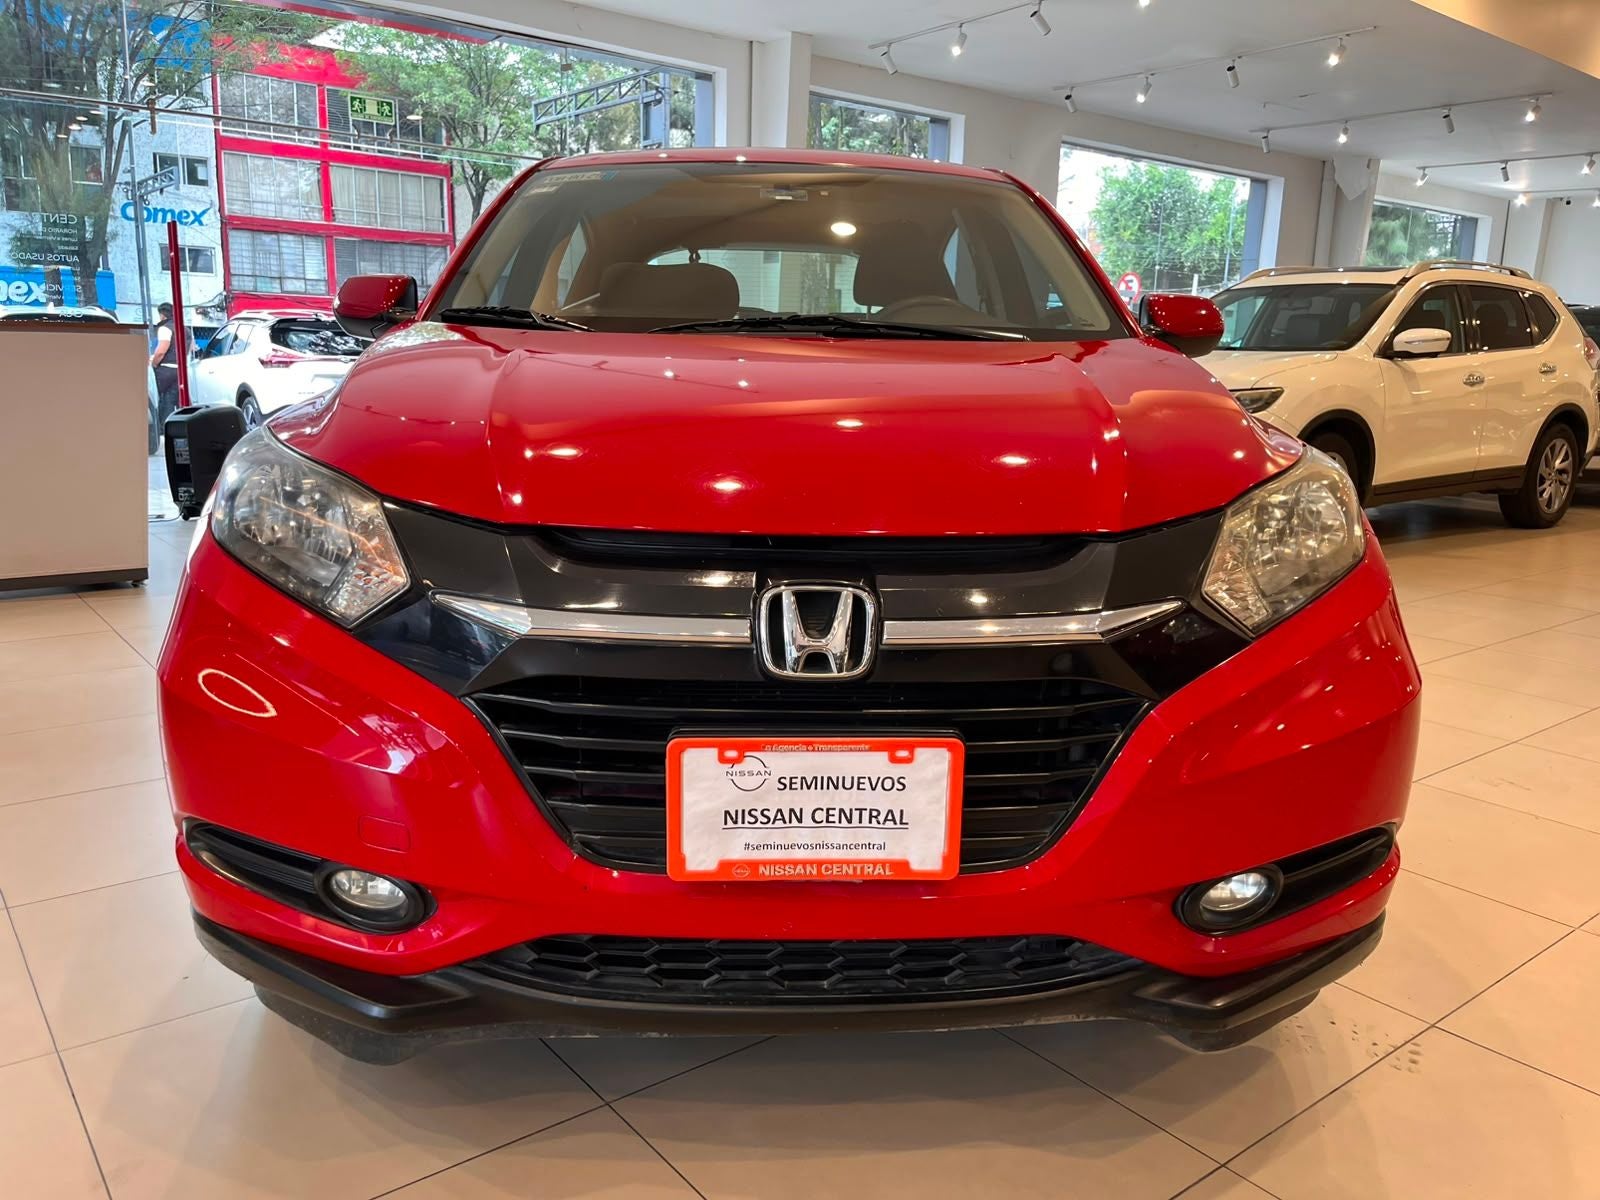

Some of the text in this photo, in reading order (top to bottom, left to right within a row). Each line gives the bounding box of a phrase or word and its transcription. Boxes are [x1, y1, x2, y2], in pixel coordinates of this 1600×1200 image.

[121, 201, 211, 226] Comex
[772, 743, 807, 752] Agencia
[814, 743, 871, 752] Transparente
[725, 769, 772, 777] NISSAN
[776, 775, 907, 792] SEMINUEVOS
[723, 807, 909, 826] NISSAN CENTRAL
[744, 841, 886, 851] #seminuevosnissancentral
[758, 864, 818, 876] NISSAN
[821, 864, 895, 876] CENTRAL
